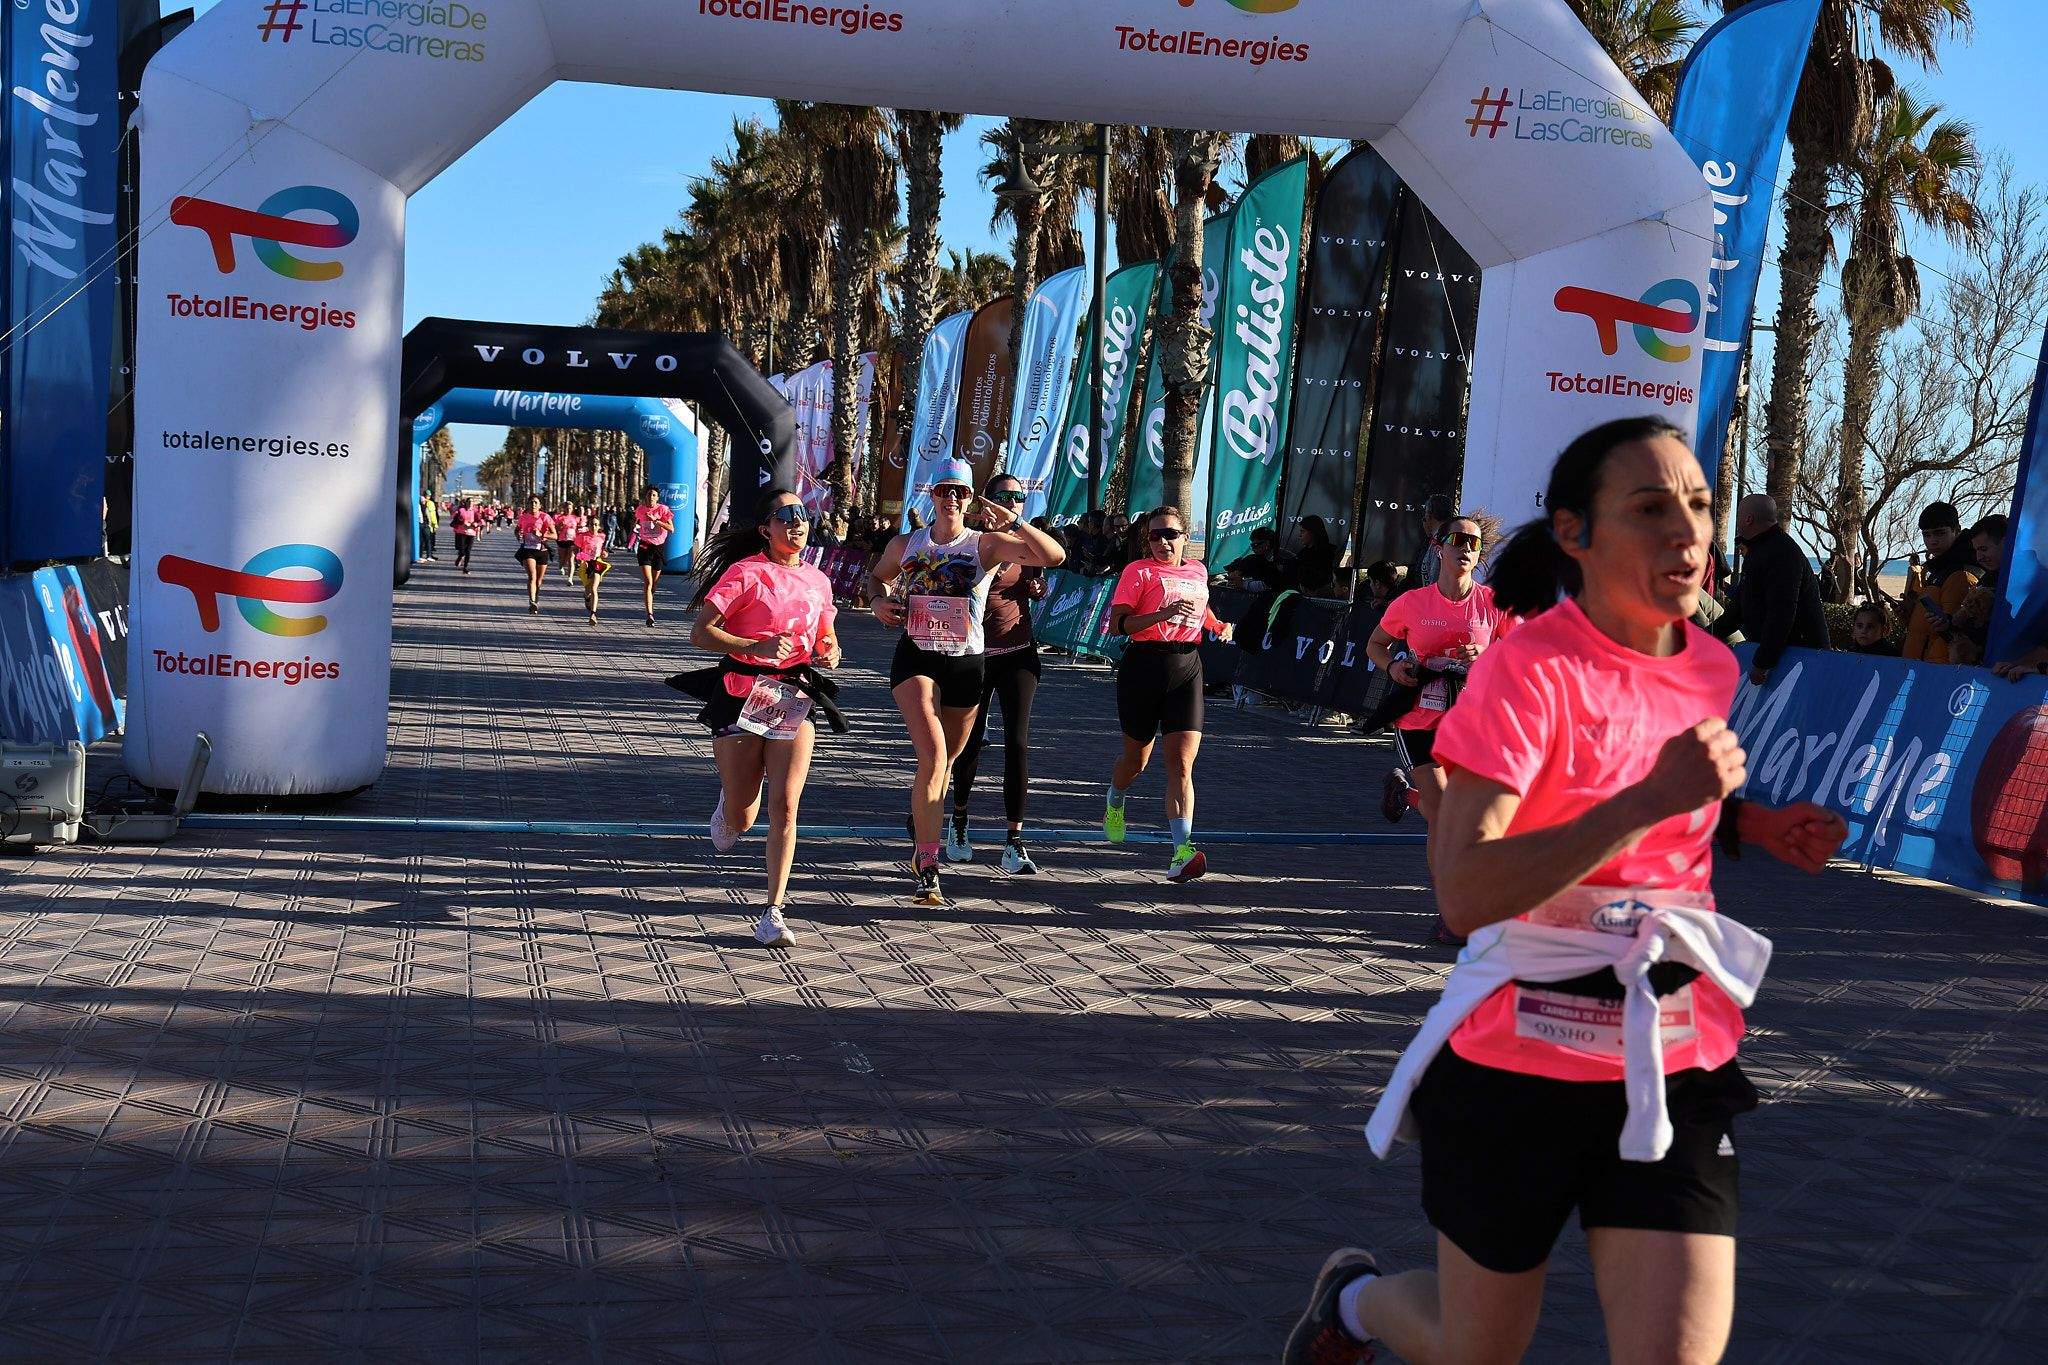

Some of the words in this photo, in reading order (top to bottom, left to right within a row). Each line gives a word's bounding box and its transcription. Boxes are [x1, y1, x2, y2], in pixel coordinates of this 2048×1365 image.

[312, 19, 485, 61] LasCarreras
[1115, 26, 1310, 65] TotalEnergies
[12, 0, 114, 279] Marlene
[1515, 116, 1653, 149] LasCarreras
[1321, 236, 1386, 247] VOLVO
[167, 294, 356, 331] TotalEnergies
[474, 345, 678, 372] VOLVO
[1223, 224, 1290, 466] Batiste
[980, 353, 997, 427] Odontológicos
[1028, 360, 1043, 411] Institutos
[1040, 337, 1057, 412] Odontológicos
[1546, 372, 1693, 406] TotalEnergies
[494, 390, 581, 420] Marlene
[970, 376, 984, 425] Institutos
[163, 430, 350, 458] totalenergies.es
[1384, 424, 1456, 438] VOLVO
[1296, 447, 1351, 458] VOLVO
[1289, 515, 1346, 526] VOVO
[1375, 500, 1426, 512] VOL
[927, 620, 950, 630] 016
[1421, 619, 1447, 627] OYSHO
[154, 650, 340, 685] TotalEnergies
[1730, 661, 1951, 847] Marlene
[1535, 1021, 1596, 1043] OYSHO
